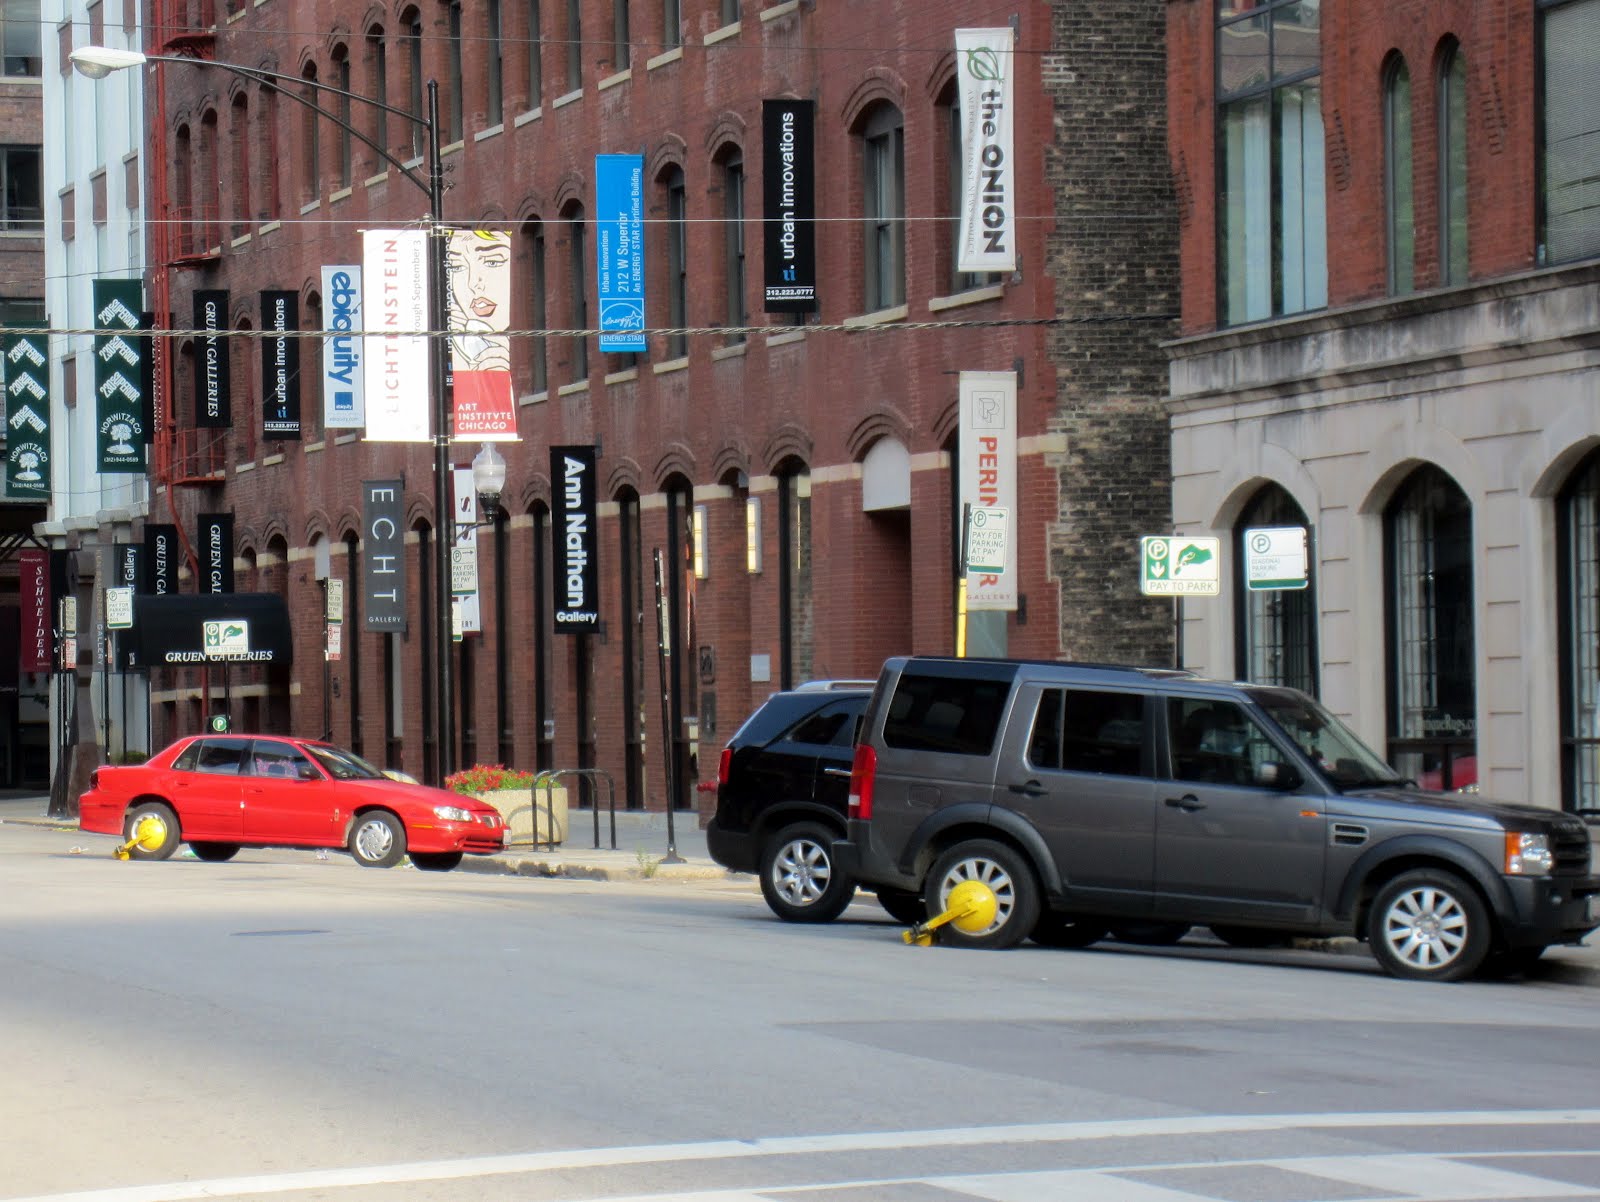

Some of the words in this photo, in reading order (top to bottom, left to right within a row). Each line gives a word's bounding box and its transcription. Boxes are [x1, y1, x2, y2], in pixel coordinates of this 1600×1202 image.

[981, 89, 1003, 137] the
[780, 112, 794, 207] innovations
[632, 168, 640, 196] Building
[632, 198, 640, 228] Certified
[981, 144, 1005, 253] ONION
[617, 211, 630, 256] Superior
[632, 229, 640, 252] STAR
[780, 212, 794, 259] urban
[602, 230, 610, 277] Innovations
[618, 259, 629, 270] W
[632, 255, 640, 282] ENERGY
[412, 247, 422, 301] September
[602, 278, 610, 293] Urban
[618, 272, 629, 293] 212
[632, 283, 640, 293] An
[98, 305, 115, 325] 230
[109, 299, 139, 330] SUPERIOR
[328, 271, 359, 385] ebiquity
[412, 304, 422, 344] Trough
[274, 299, 286, 366] innovations
[603, 334, 626, 342] ENERGY
[8, 345, 25, 363] 230
[18, 338, 45, 367] SUPERIOR
[99, 342, 116, 361] 230
[110, 335, 140, 366] SUPERIOR
[9, 378, 26, 396] 230
[18, 371, 46, 400] SUPERIOR
[100, 378, 117, 398] 230
[111, 371, 140, 403] SUPERIOR
[207, 348, 218, 417] GALLERIES
[275, 369, 286, 402] urban
[10, 411, 26, 429] 230
[19, 404, 47, 434] SUPERIOR
[458, 403, 477, 411] ART
[458, 412, 512, 420] INSTITVTE
[458, 422, 507, 430] CHICAGO
[564, 456, 586, 508] Ann
[979, 437, 998, 588] PERIR
[156, 535, 166, 576] GRUEN
[210, 525, 220, 568] GRUEN
[371, 488, 396, 602] ECHT
[971, 540, 1004, 548] PARKING
[124, 547, 136, 580] Gallery
[566, 514, 587, 607] Nathan
[1150, 582, 1168, 591] PAY
[1172, 582, 1184, 591] TO
[1187, 582, 1214, 591] PARK
[35, 566, 45, 659] SCHNEIDER
[556, 611, 597, 624] Gallery
[165, 652, 206, 662] GRUEN
[210, 651, 273, 662] GALLERIES
